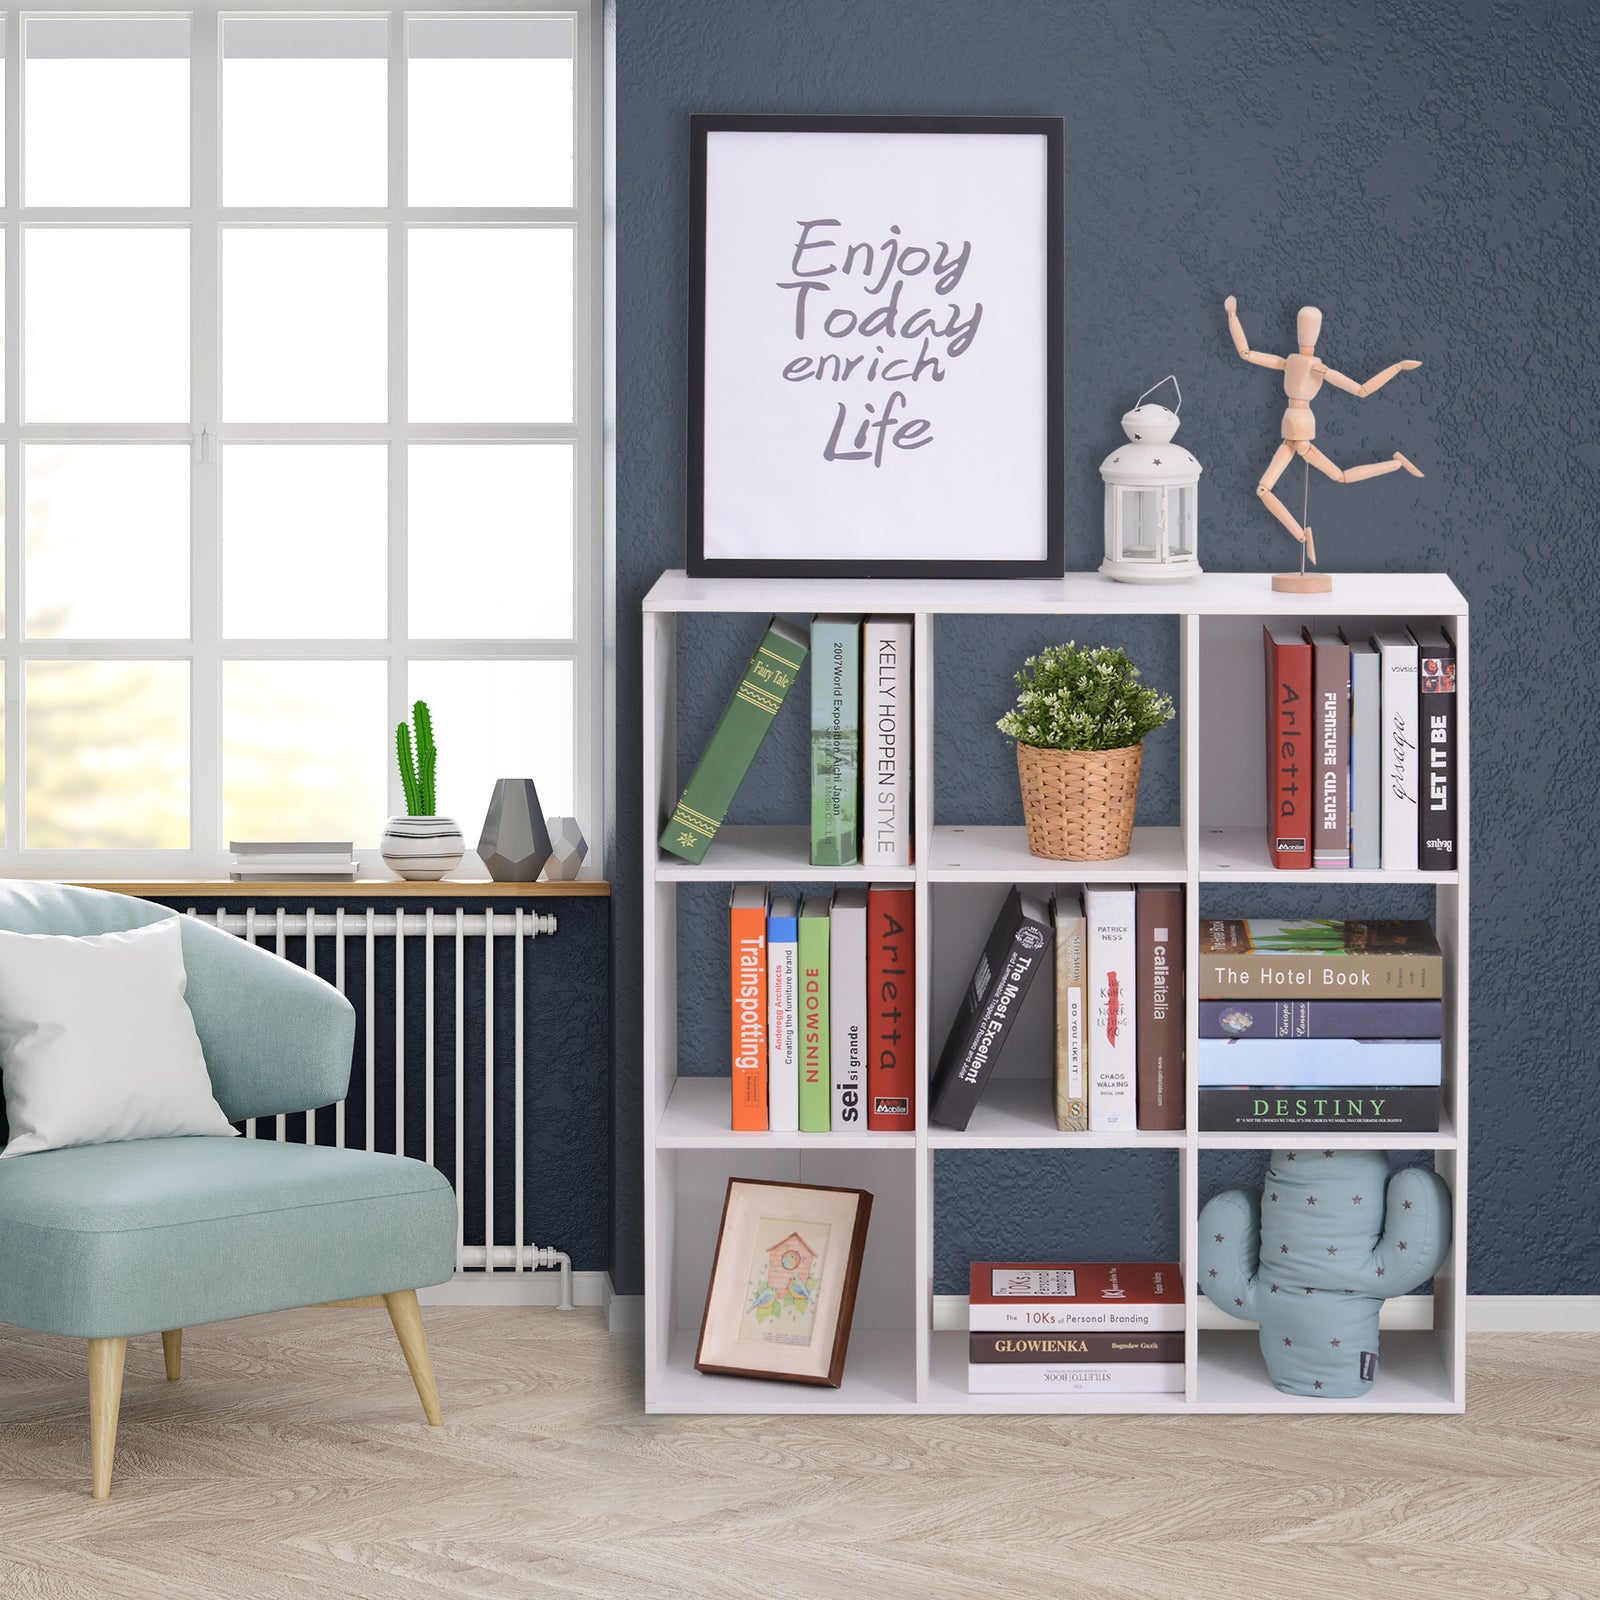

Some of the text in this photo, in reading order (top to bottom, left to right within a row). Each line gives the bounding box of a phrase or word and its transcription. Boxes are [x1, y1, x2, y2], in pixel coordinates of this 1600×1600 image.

[791, 218, 972, 296] Enjoy
[775, 279, 983, 358] Today
[782, 337, 946, 382] enrich
[823, 390, 934, 468] Life
[753, 660, 790, 688] Fairy Tale
[831, 642, 843, 816] 2007World Exposition Aichi Japan
[877, 640, 896, 852] KELLY HOPPEN STYLE
[1281, 683, 1301, 817] Arletta
[1324, 693, 1336, 830] FURNITURE CULTURE
[1430, 715, 1447, 811] LET IT BE
[880, 912, 906, 1070] Arletta
[1010, 956, 1033, 983] The
[1153, 945, 1169, 1020] caliaitalia
[1215, 968, 1370, 986] The Hotel Book
[735, 935, 765, 1069] Trainspotting
[984, 998, 997, 1021] Tragedy
[995, 984, 1020, 1019] Most
[1072, 1003, 1078, 1017] DO
[1279, 1003, 1291, 1037] Europe
[775, 1010, 784, 1051] Anderegg
[785, 1029, 794, 1065] Creating
[806, 968, 819, 1083] NINSMODE
[971, 1027, 985, 1051] Romeo
[837, 1025, 861, 1122] sei si grande
[964, 1019, 1002, 1084] Excellent
[1072, 1064, 1078, 1074] IT
[1253, 1099, 1386, 1116] DESTINY
[1026, 1312, 1056, 1324] 10Ks
[1067, 1314, 1106, 1323] Personal
[1110, 1314, 1149, 1325] Branding
[1044, 1373, 1112, 1382] STILETTO BOOK
